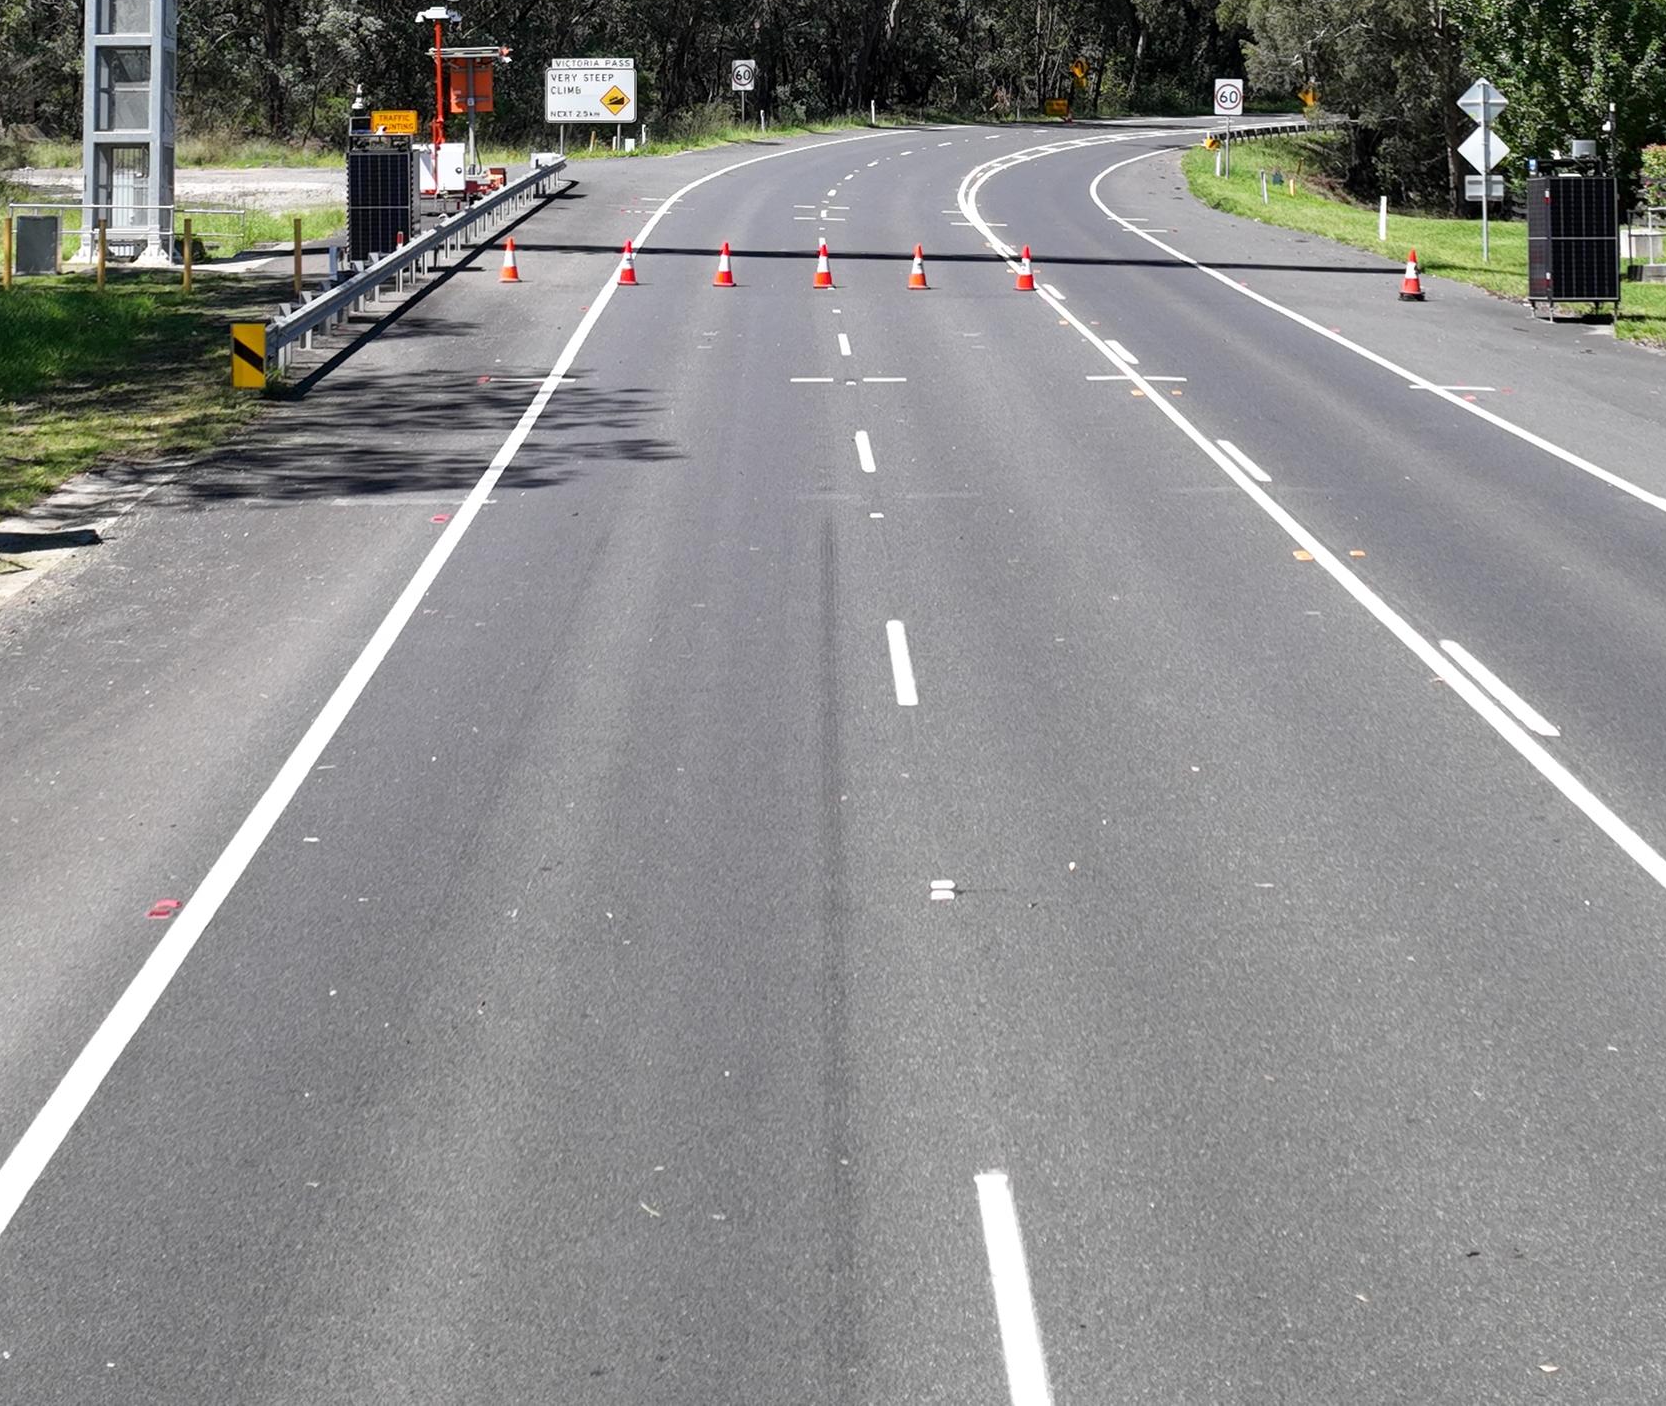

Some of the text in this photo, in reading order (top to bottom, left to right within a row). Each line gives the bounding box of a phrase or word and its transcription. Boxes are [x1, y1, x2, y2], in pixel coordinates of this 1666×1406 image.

[551, 74, 614, 82] VERY STEEP
[736, 70, 751, 80] 60
[550, 86, 581, 95] CLIMB
[1219, 90, 1238, 103] 60
[378, 114, 410, 122] TRAFFIC
